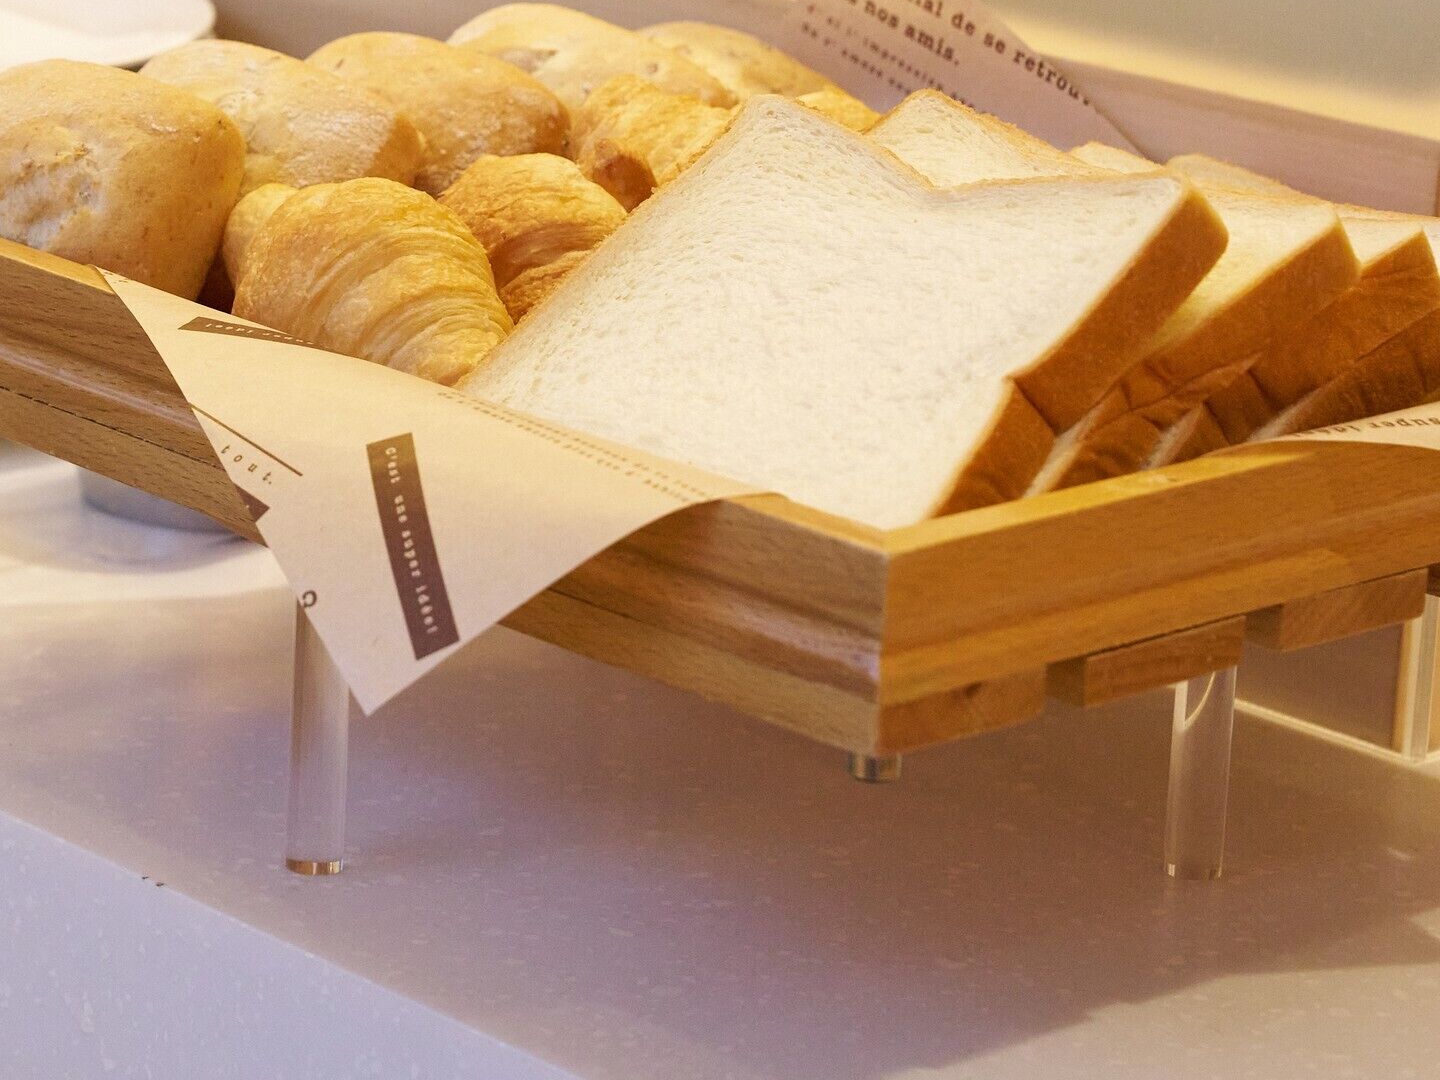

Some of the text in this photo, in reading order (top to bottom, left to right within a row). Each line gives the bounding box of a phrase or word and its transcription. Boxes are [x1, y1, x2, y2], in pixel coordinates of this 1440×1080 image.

[864, 0, 900, 30] nos
[904, 23, 961, 66] amis.
[951, 12, 976, 37] de
[983, 31, 1006, 55] se
[220, 443, 274, 486] tout.
[385, 445, 402, 485] C'est
[394, 493, 408, 524] une
[401, 529, 422, 578] super
